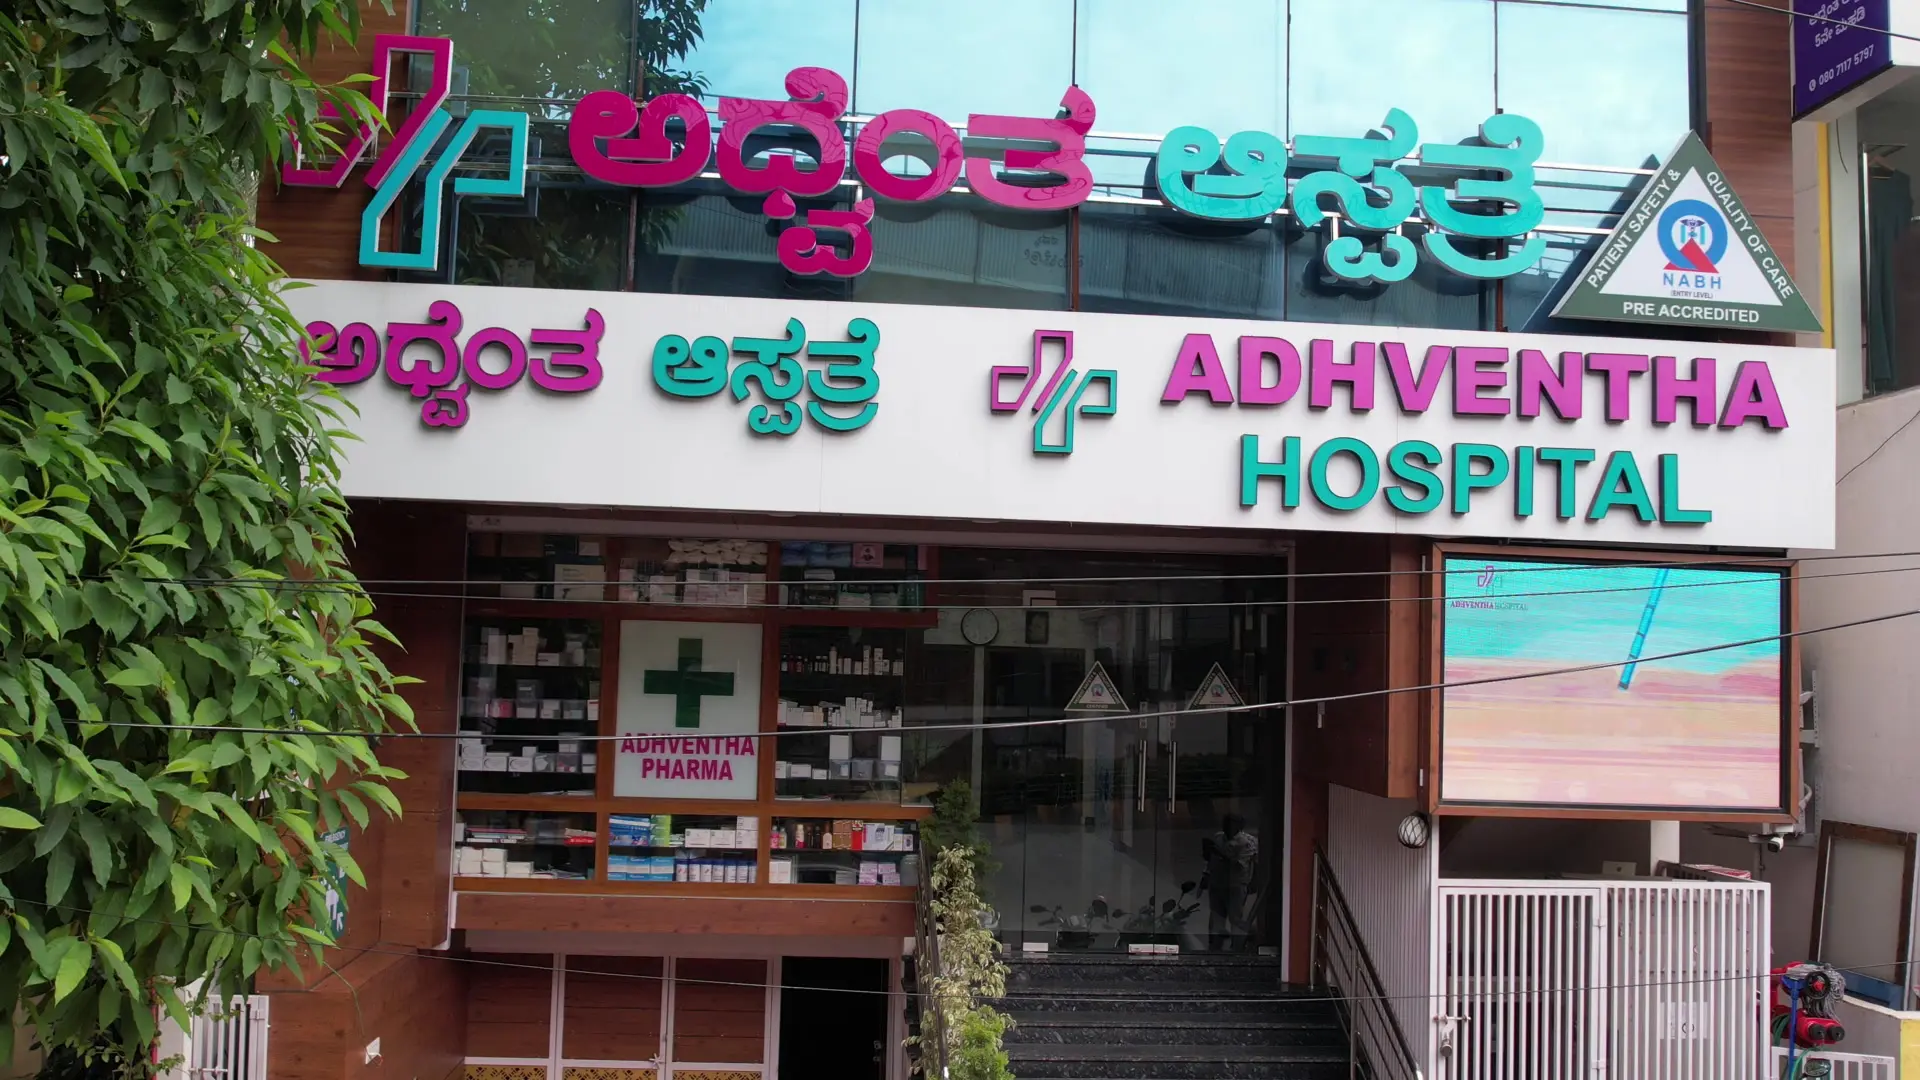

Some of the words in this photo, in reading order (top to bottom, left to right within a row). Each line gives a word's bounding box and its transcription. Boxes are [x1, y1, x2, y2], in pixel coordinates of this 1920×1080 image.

[1818, 69, 1835, 85] 080
[1836, 58, 1852, 77] 7117
[1854, 44, 1874, 65] 5797
[1156, 107, 1546, 283] ಆಸ್ಪತ್ರೆ
[1587, 233, 1635, 288] PATIENT
[1629, 178, 1672, 233] SAFETY
[1667, 168, 1681, 182] &
[1706, 171, 1753, 233] QUALITY
[1747, 232, 1766, 254] OF
[1762, 256, 1795, 300] CARE
[1623, 302, 1655, 316] PRE
[1658, 304, 1760, 323] ACCREDITED
[1663, 272, 1722, 290] NABH
[651, 316, 880, 437] ಆಸ್ಪತ್ರೆ
[1160, 332, 1789, 430] ADHVENTHA
[1240, 434, 1713, 525] HOSPITAL
[620, 732, 756, 756] ADHVENTHA
[641, 757, 733, 781] PHARMA
